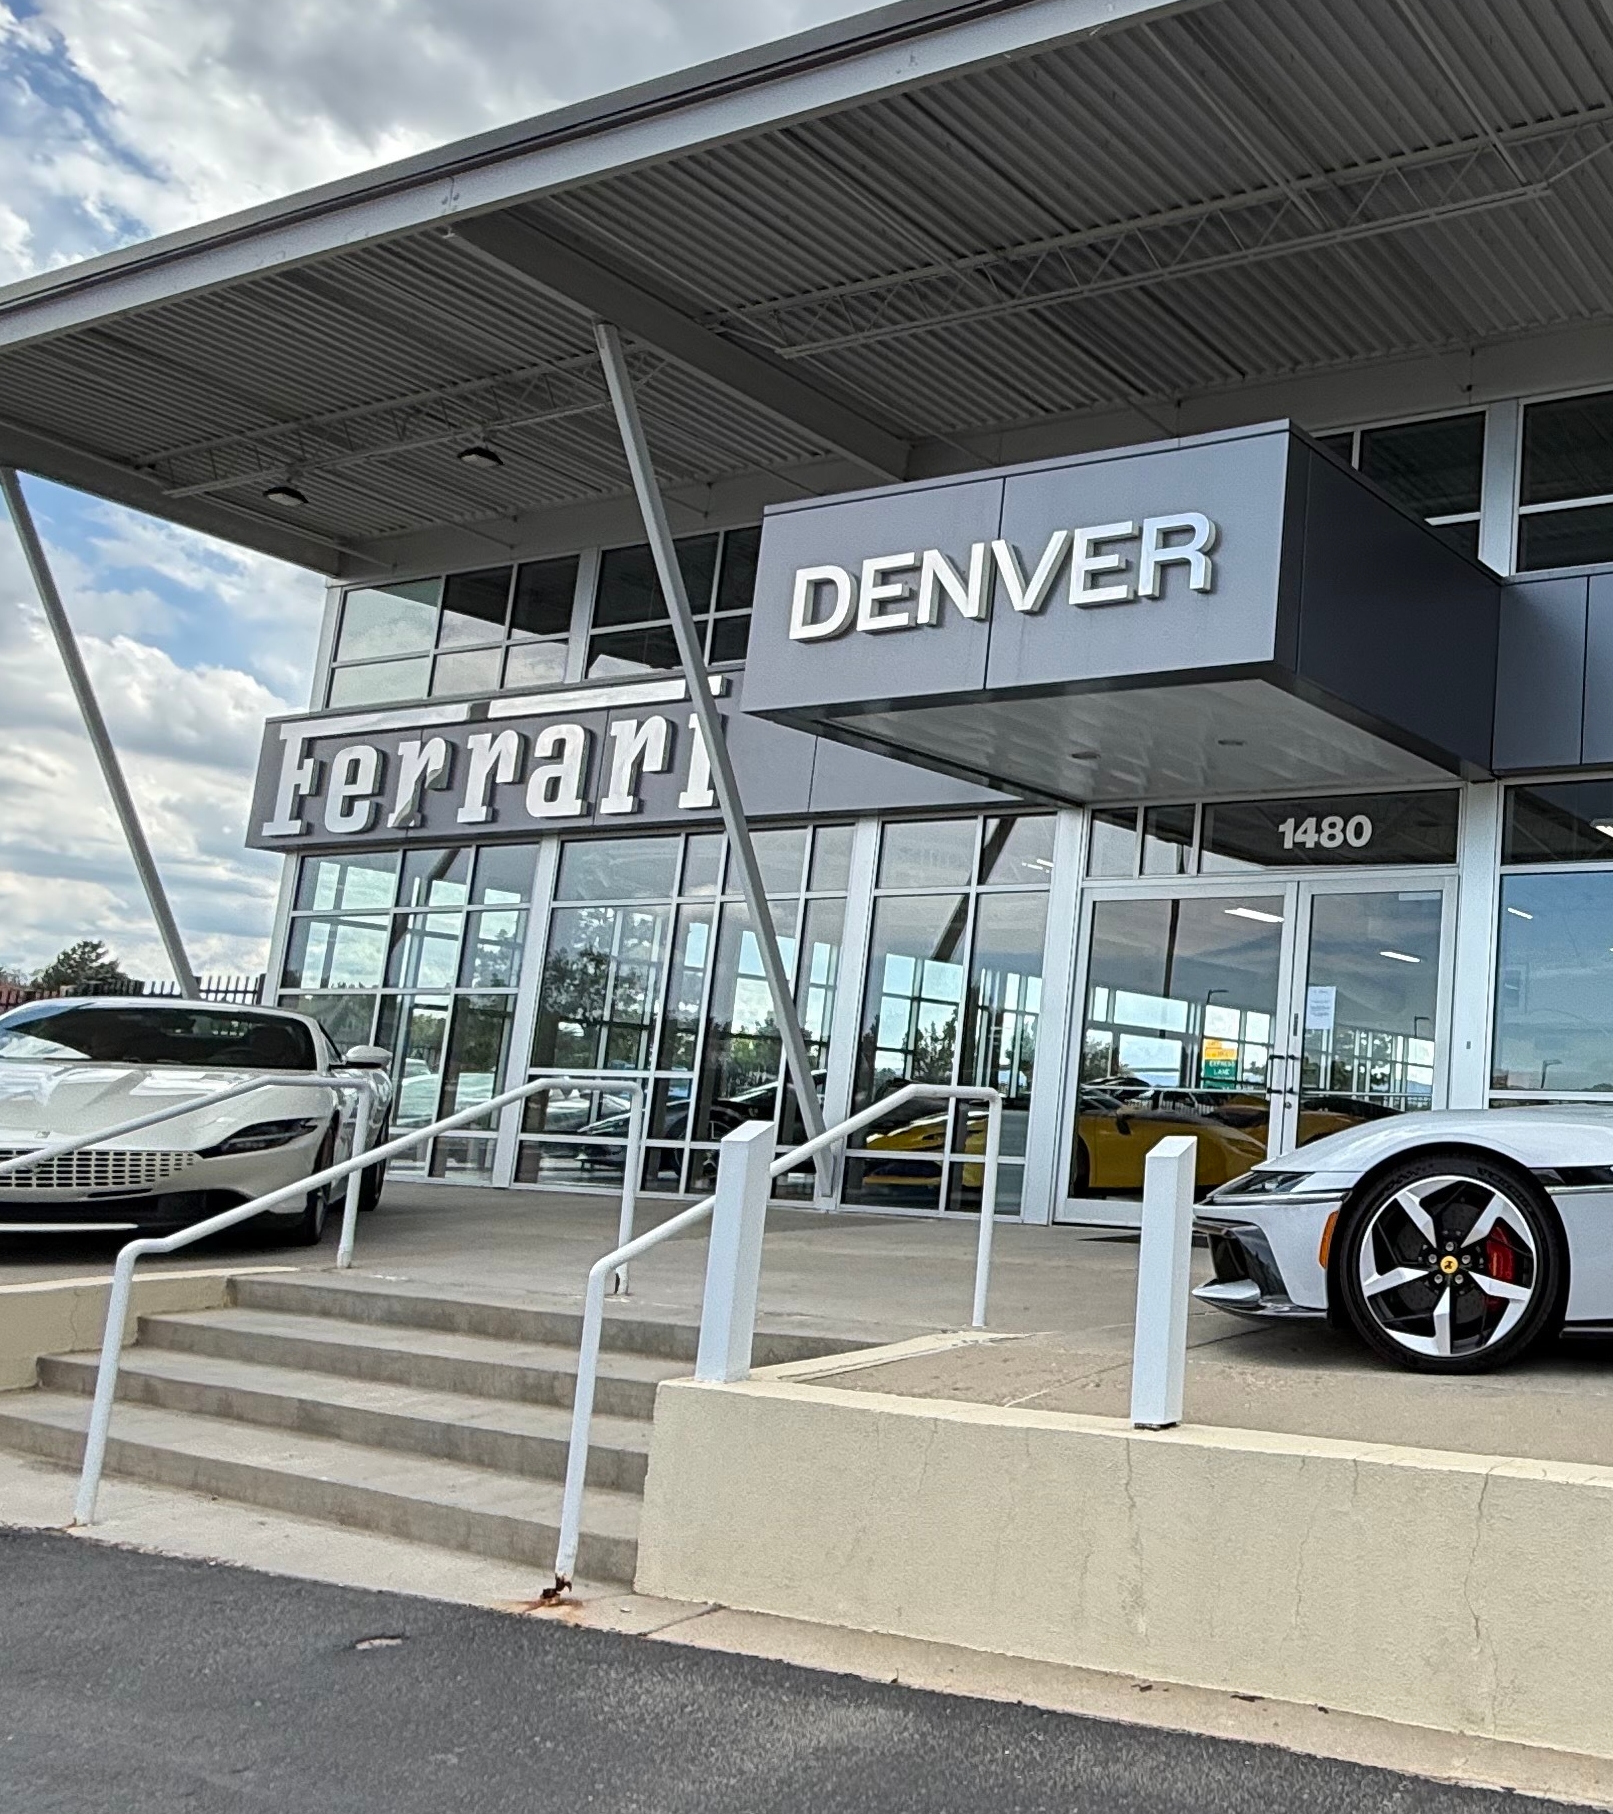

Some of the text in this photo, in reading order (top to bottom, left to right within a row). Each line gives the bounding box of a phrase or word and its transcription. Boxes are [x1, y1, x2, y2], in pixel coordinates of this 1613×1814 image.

[789, 512, 1217, 641] DENVER
[262, 675, 725, 836] Ferrari
[1278, 814, 1373, 849] 1480
